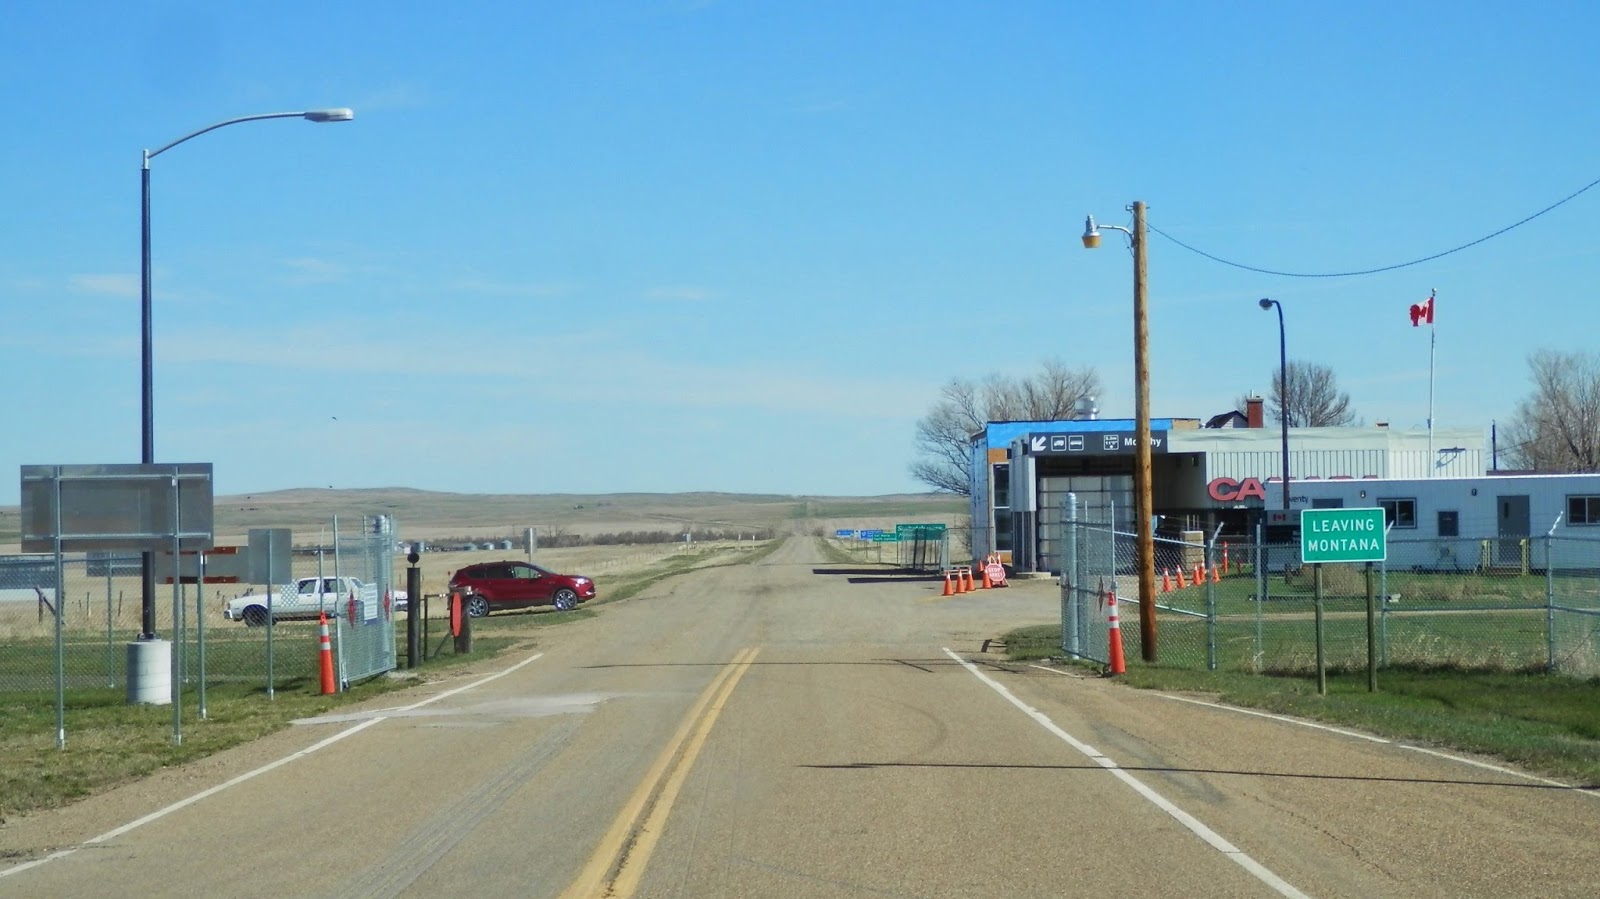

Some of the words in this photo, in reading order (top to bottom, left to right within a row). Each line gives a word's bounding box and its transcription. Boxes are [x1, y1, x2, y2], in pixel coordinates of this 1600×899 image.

[1124, 437, 1162, 448] Mohy
[1312, 519, 1375, 533] LEAVING
[1308, 538, 1380, 552] MONTANA
